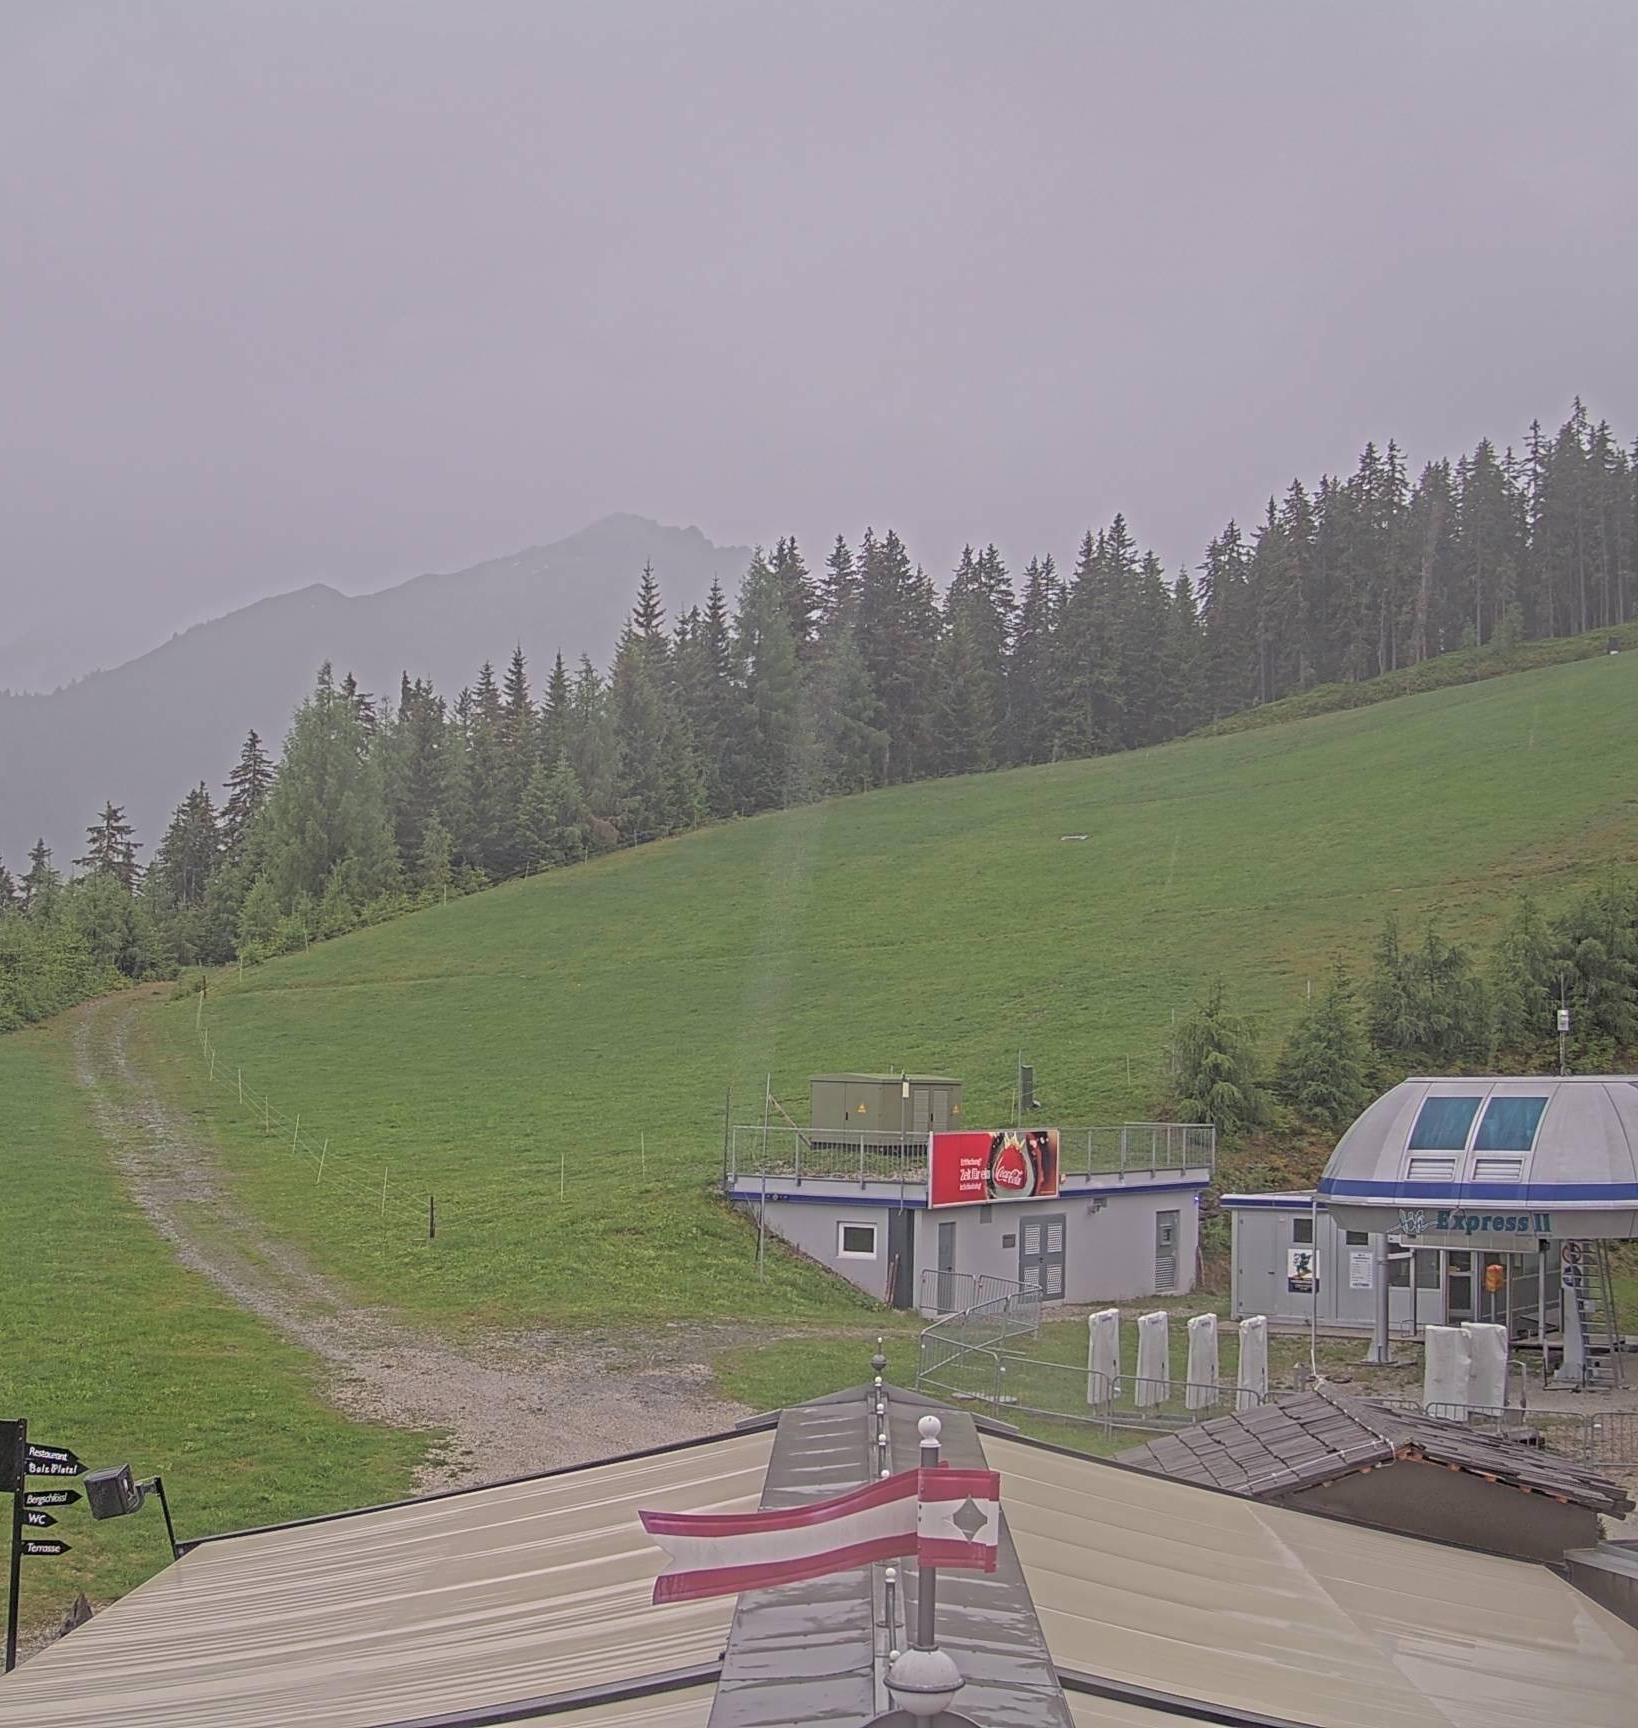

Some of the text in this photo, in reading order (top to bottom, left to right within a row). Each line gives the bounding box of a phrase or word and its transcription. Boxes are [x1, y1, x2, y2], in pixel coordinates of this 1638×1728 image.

[1436, 1210, 1529, 1235] Express
[28, 1513, 47, 1525] WC
[27, 1542, 61, 1553] Terrasse
